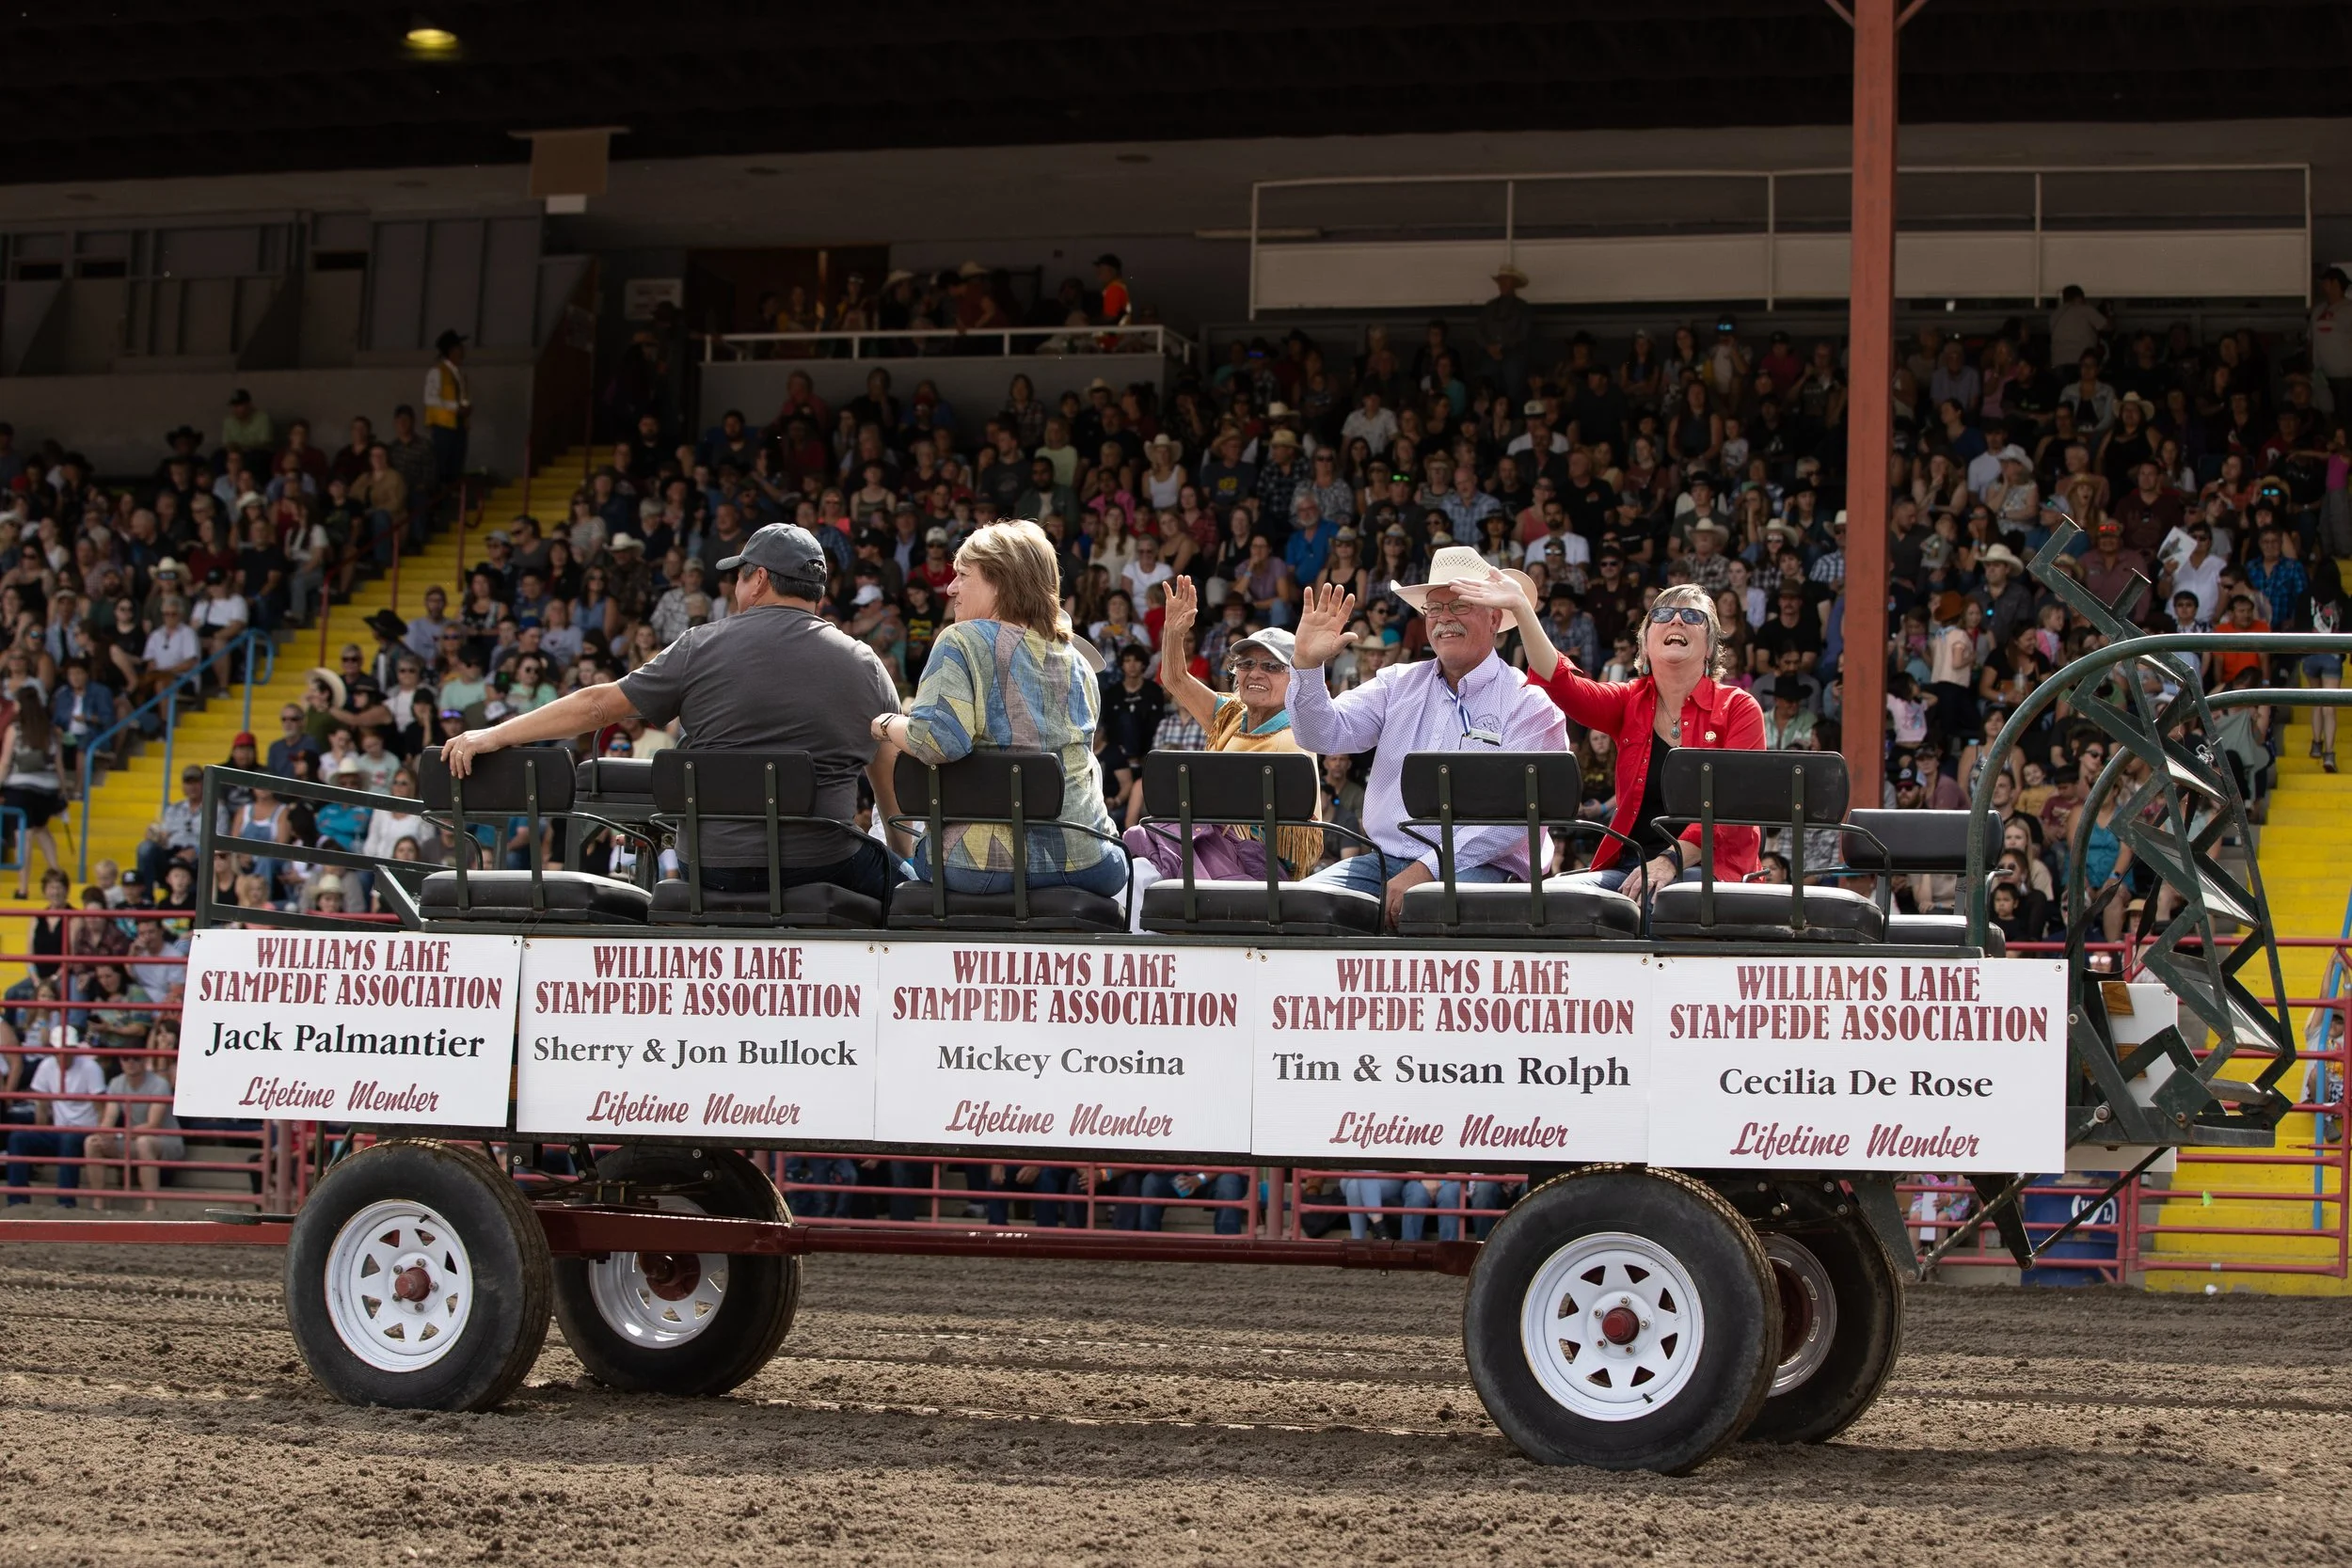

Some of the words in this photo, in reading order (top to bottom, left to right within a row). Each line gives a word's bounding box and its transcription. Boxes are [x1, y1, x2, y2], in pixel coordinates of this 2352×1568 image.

[258, 938, 376, 971] WILLIAMS
[386, 941, 450, 973] LAKE
[594, 946, 723, 979] WILLIAMS
[734, 947, 802, 980] LAKE
[953, 951, 1091, 986] WILLIAMS
[1103, 954, 1175, 988] LAKE
[199, 971, 326, 1004] STAMPEDE
[335, 974, 501, 1009] ASSOCIATION
[1337, 958, 1479, 993] WILLIAMS
[1493, 960, 1568, 994] LAKE
[1738, 966, 1887, 1001] WILLIAMS
[1900, 967, 1979, 1002] LAKE
[536, 981, 672, 1015] STAMPEDE
[683, 983, 860, 1017] ASSOCIATION
[893, 987, 1037, 1022] STAMPEDE
[1048, 990, 1236, 1026] ASSOCIATION
[1273, 996, 1423, 1031] STAMPEDE
[1436, 998, 1633, 1034] ASSOCIATION
[205, 1022, 282, 1056] Jack
[294, 1024, 485, 1057] Palmantier
[1670, 1005, 1829, 1039] STAMPEDE
[1841, 1006, 2047, 1041] ASSOCIATION
[534, 1037, 633, 1069] Sherry
[643, 1039, 665, 1062] &
[672, 1040, 727, 1069] Jon
[738, 1039, 857, 1065] Bullock
[938, 1045, 1051, 1079] Mickey
[1061, 1049, 1184, 1075] Crosina
[1273, 1053, 1341, 1081] Tim
[1354, 1054, 1381, 1082] &
[1396, 1055, 1504, 1084] Susan
[1518, 1056, 1630, 1094] Rolph
[1720, 1068, 1836, 1095] Cecilia
[1850, 1070, 1896, 1096] De
[1910, 1071, 1993, 1097] Rose
[239, 1077, 334, 1111] Lifetime
[348, 1081, 438, 1112] Member
[586, 1091, 689, 1126] Lifetime
[704, 1093, 800, 1125] Member
[946, 1101, 1054, 1136] Lifetime
[1070, 1104, 1172, 1136] Member
[1329, 1112, 1443, 1148] Lifetime
[1460, 1115, 1568, 1148] Member
[1730, 1122, 1850, 1160] Lifetime
[1867, 1124, 1979, 1158] Member
